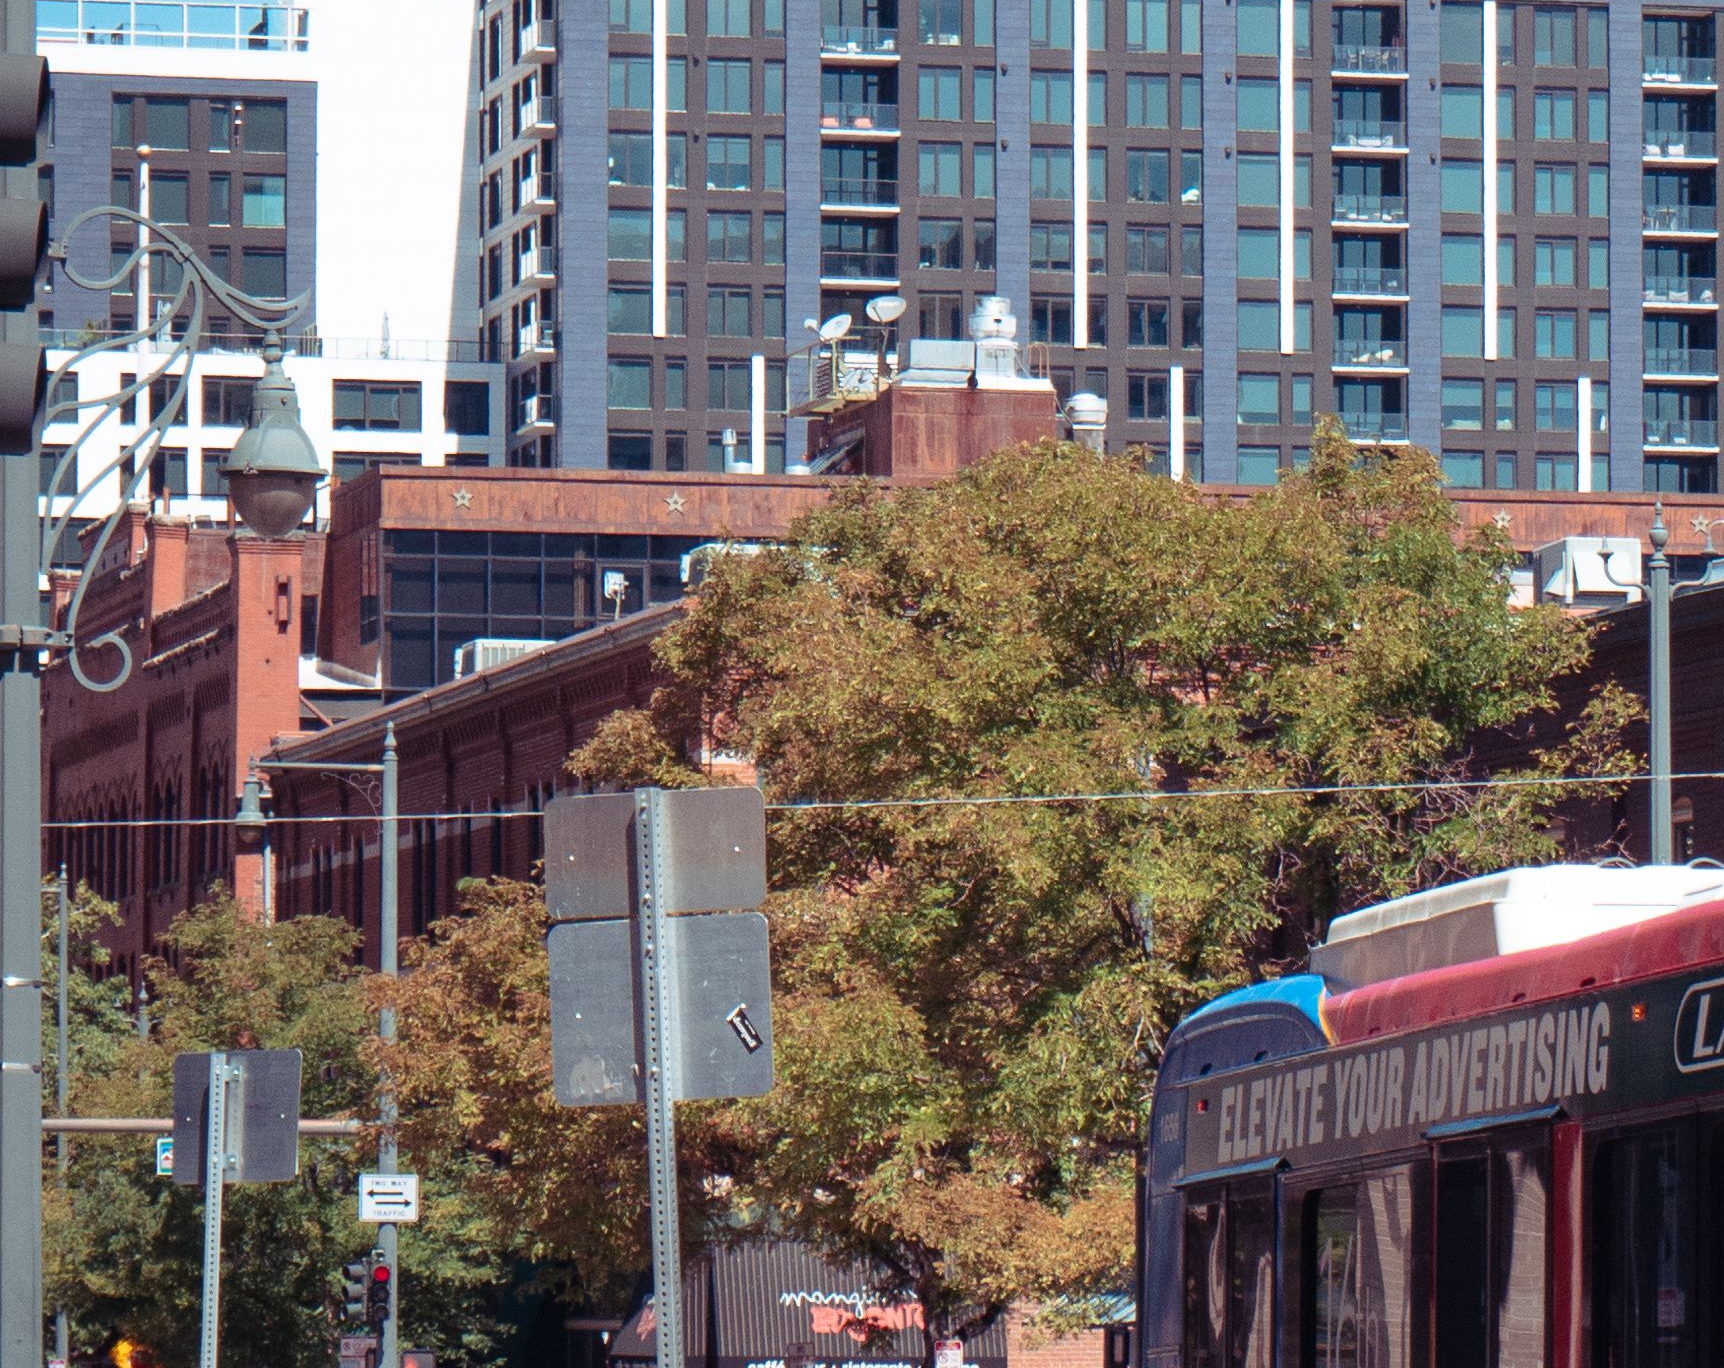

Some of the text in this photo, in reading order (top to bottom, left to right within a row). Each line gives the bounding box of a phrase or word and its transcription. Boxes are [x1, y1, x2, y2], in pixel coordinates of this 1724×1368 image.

[1218, 1001, 1611, 1164] ELEVATE YOUR ADVERTISING
